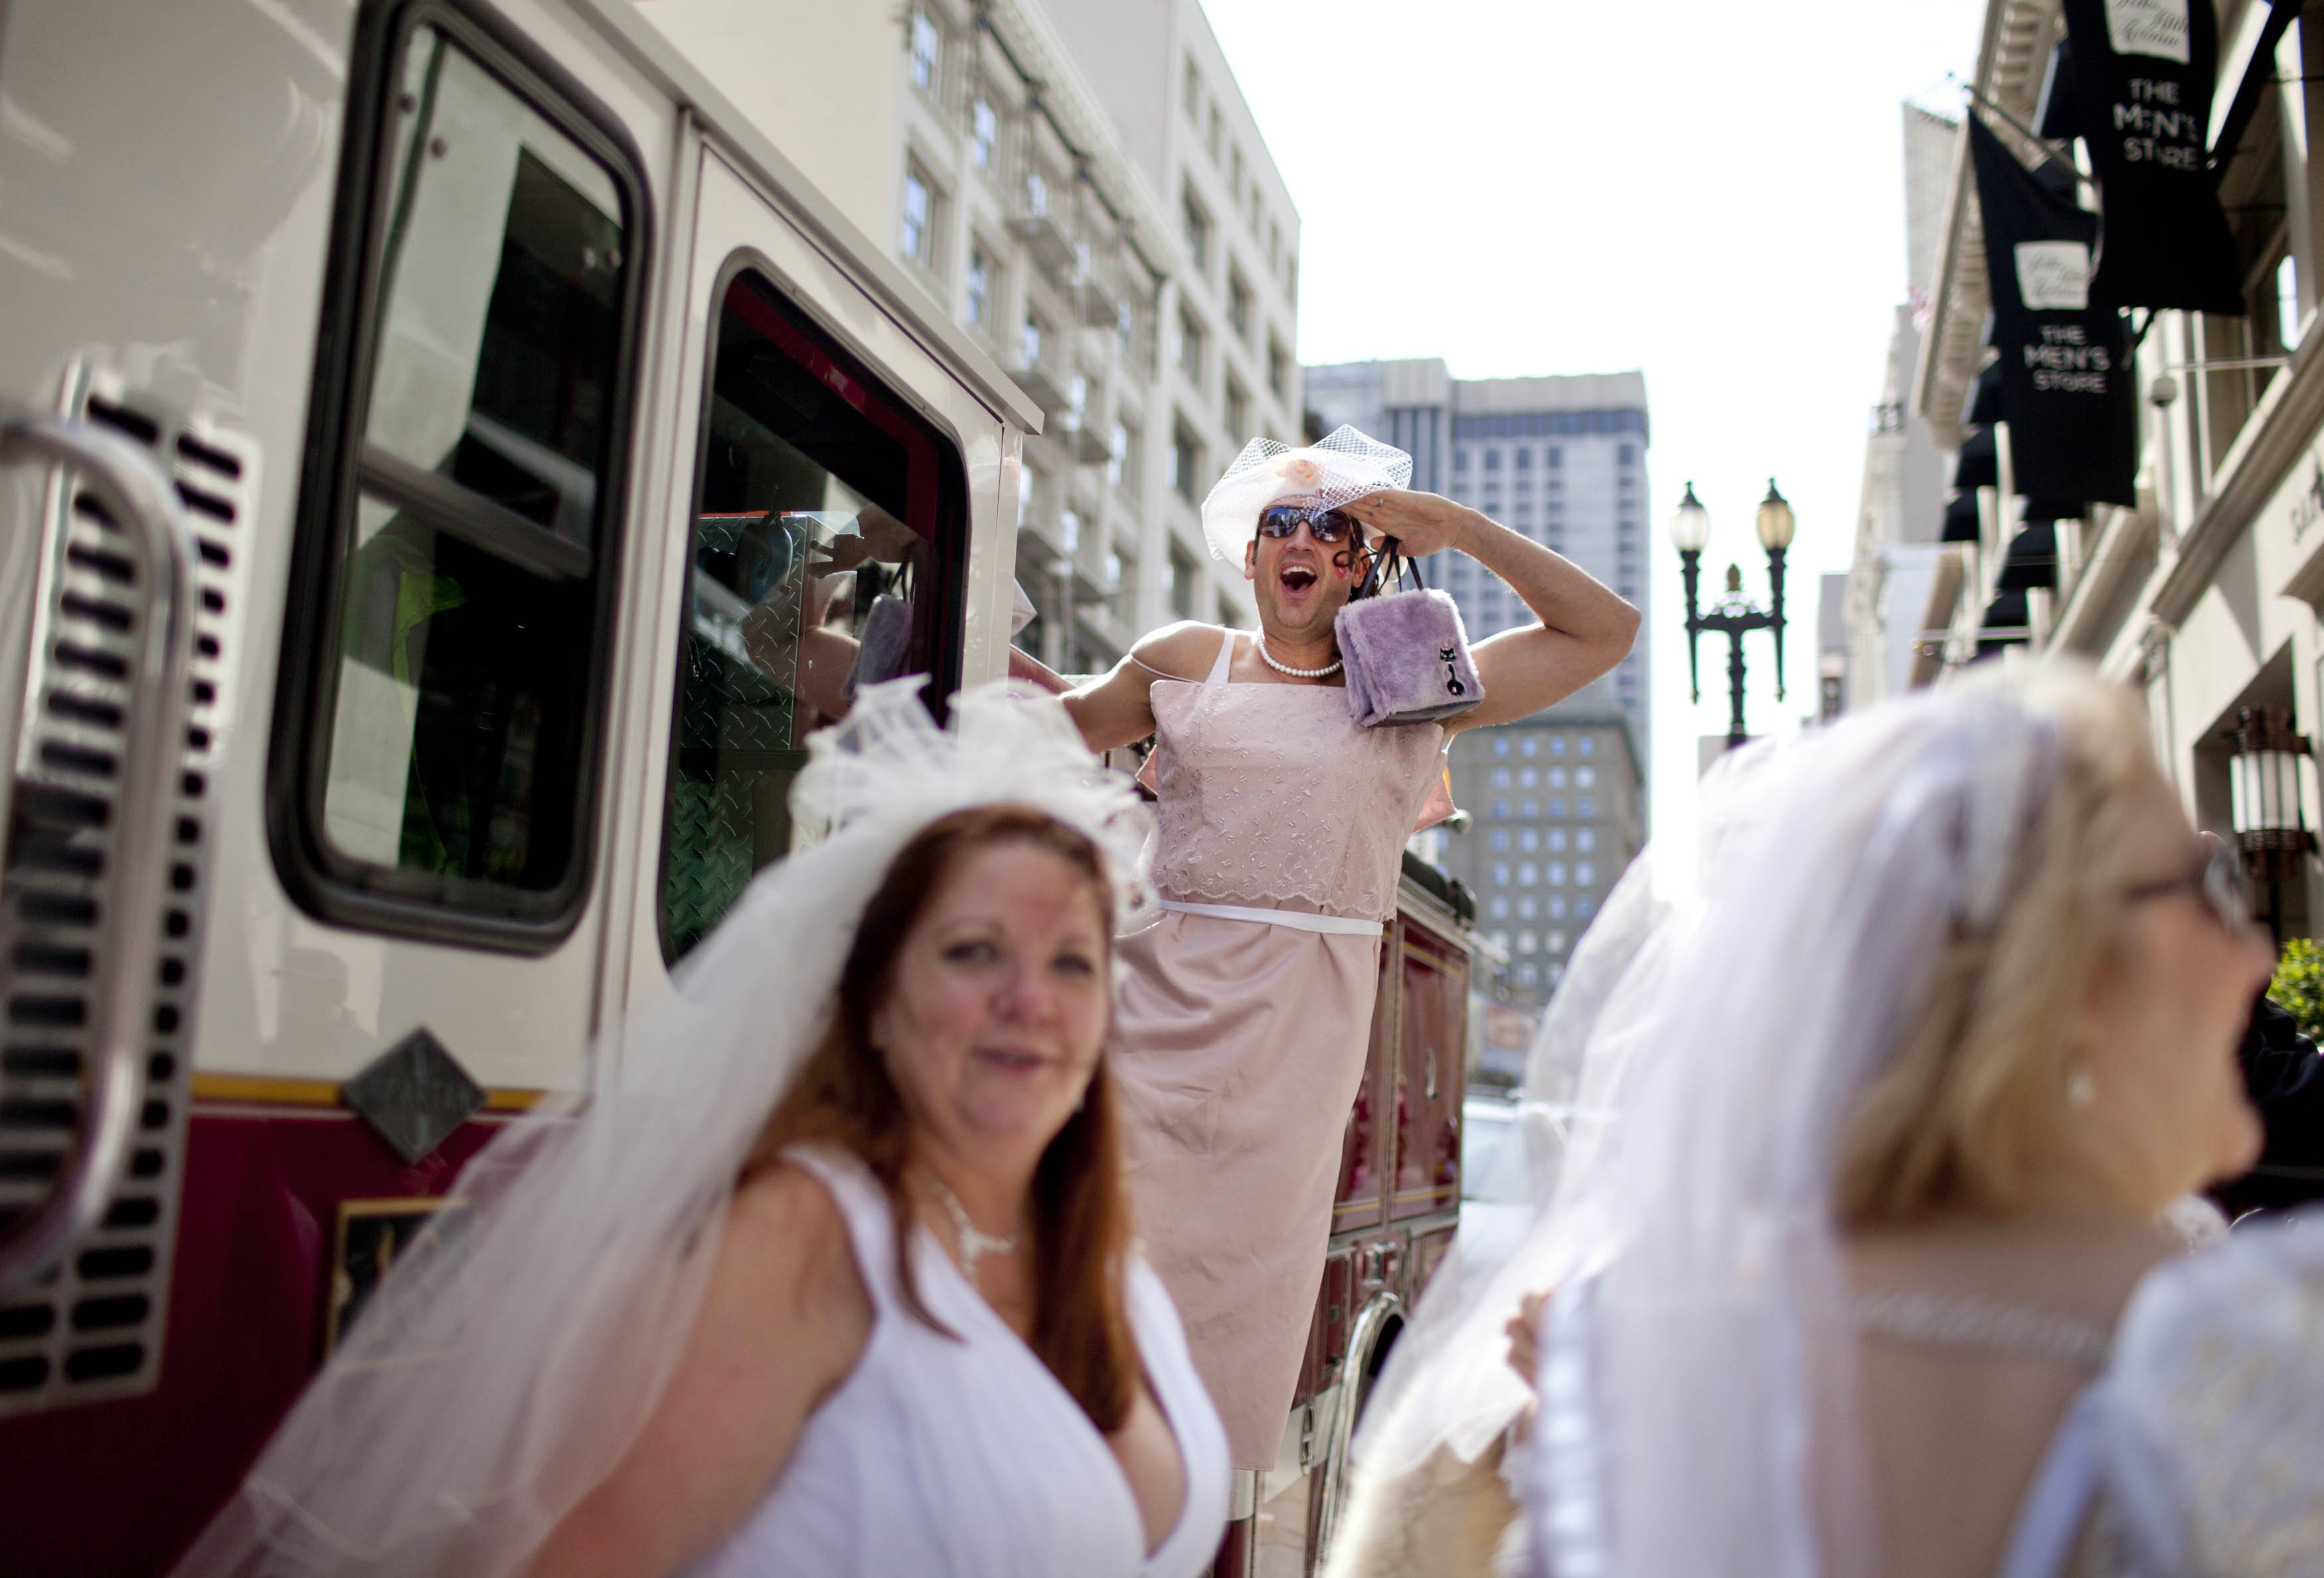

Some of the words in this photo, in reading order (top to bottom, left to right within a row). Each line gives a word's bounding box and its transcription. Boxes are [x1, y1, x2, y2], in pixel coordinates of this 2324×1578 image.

[2127, 78, 2181, 105] THE
[2040, 325, 2086, 345] THE
[2023, 344, 2111, 371] MEN'S
[2033, 369, 2108, 394] STORE
